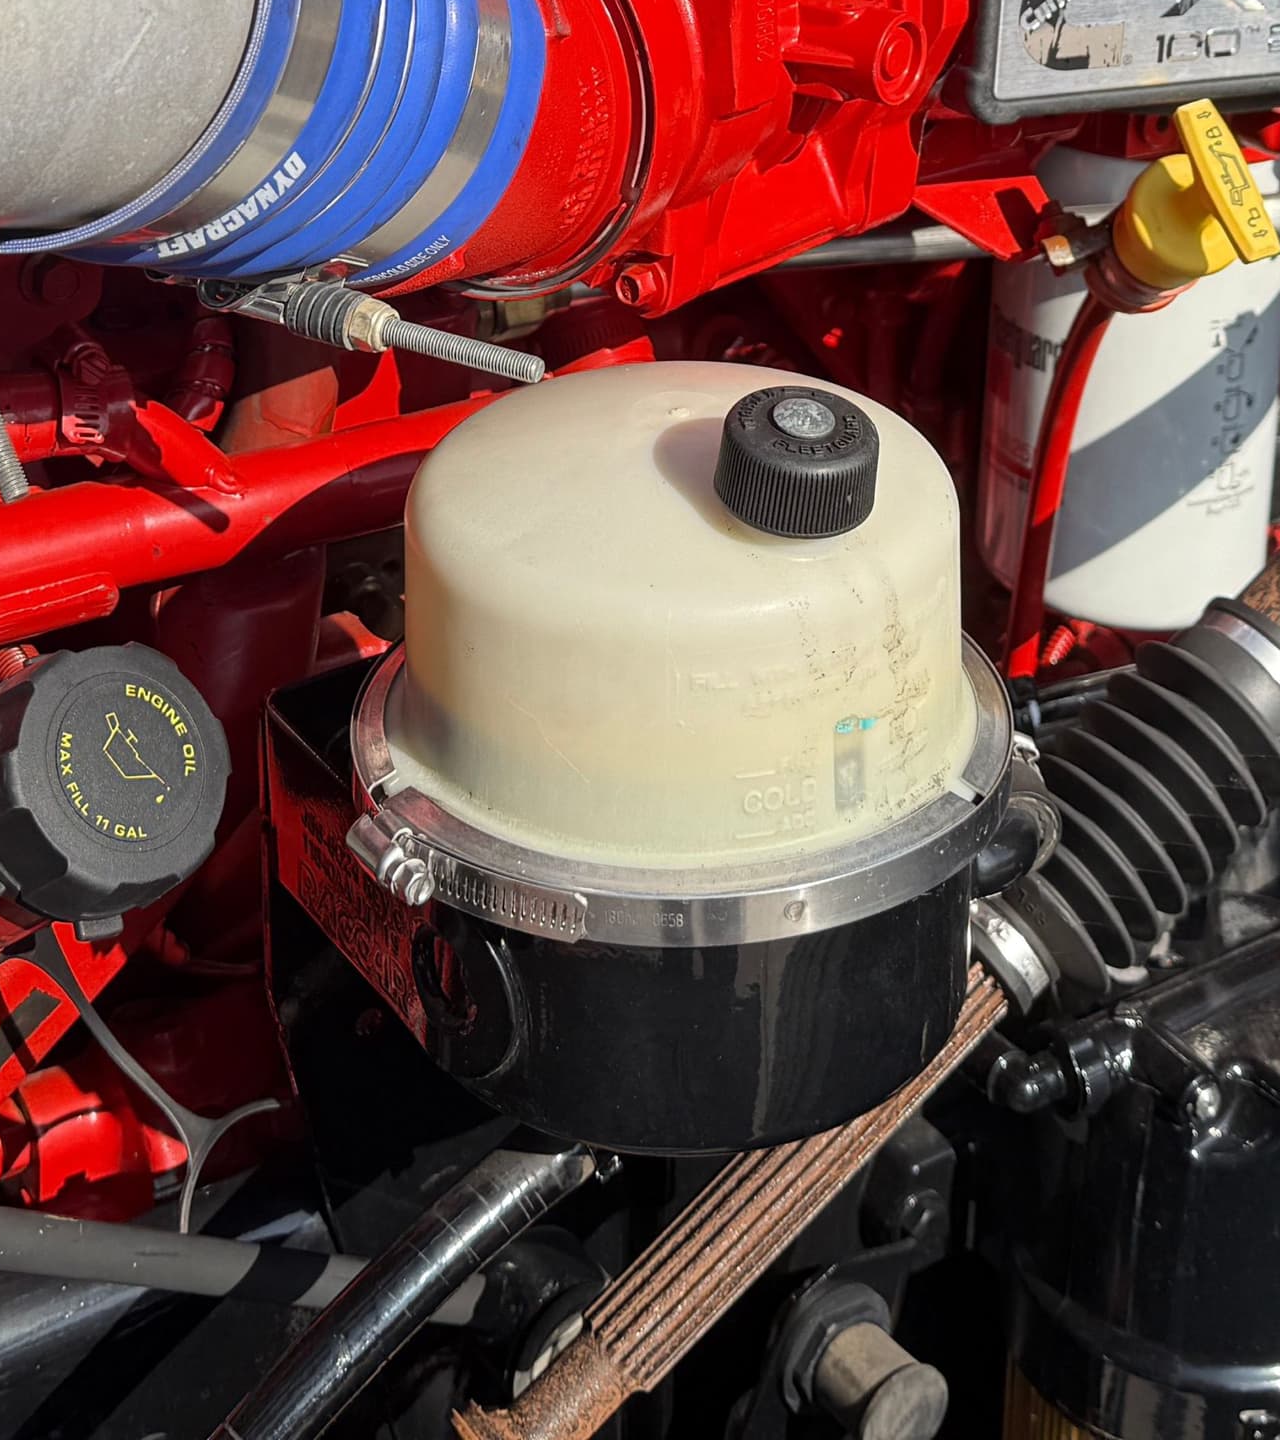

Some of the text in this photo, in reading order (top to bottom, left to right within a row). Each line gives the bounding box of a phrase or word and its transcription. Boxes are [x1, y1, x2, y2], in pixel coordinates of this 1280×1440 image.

[158, 150, 308, 260] DYNACRAFT
[125, 683, 197, 777] ENGINE OIL
[59, 731, 148, 839] MAX FILL 11 GAL
[742, 777, 818, 814] COLD
